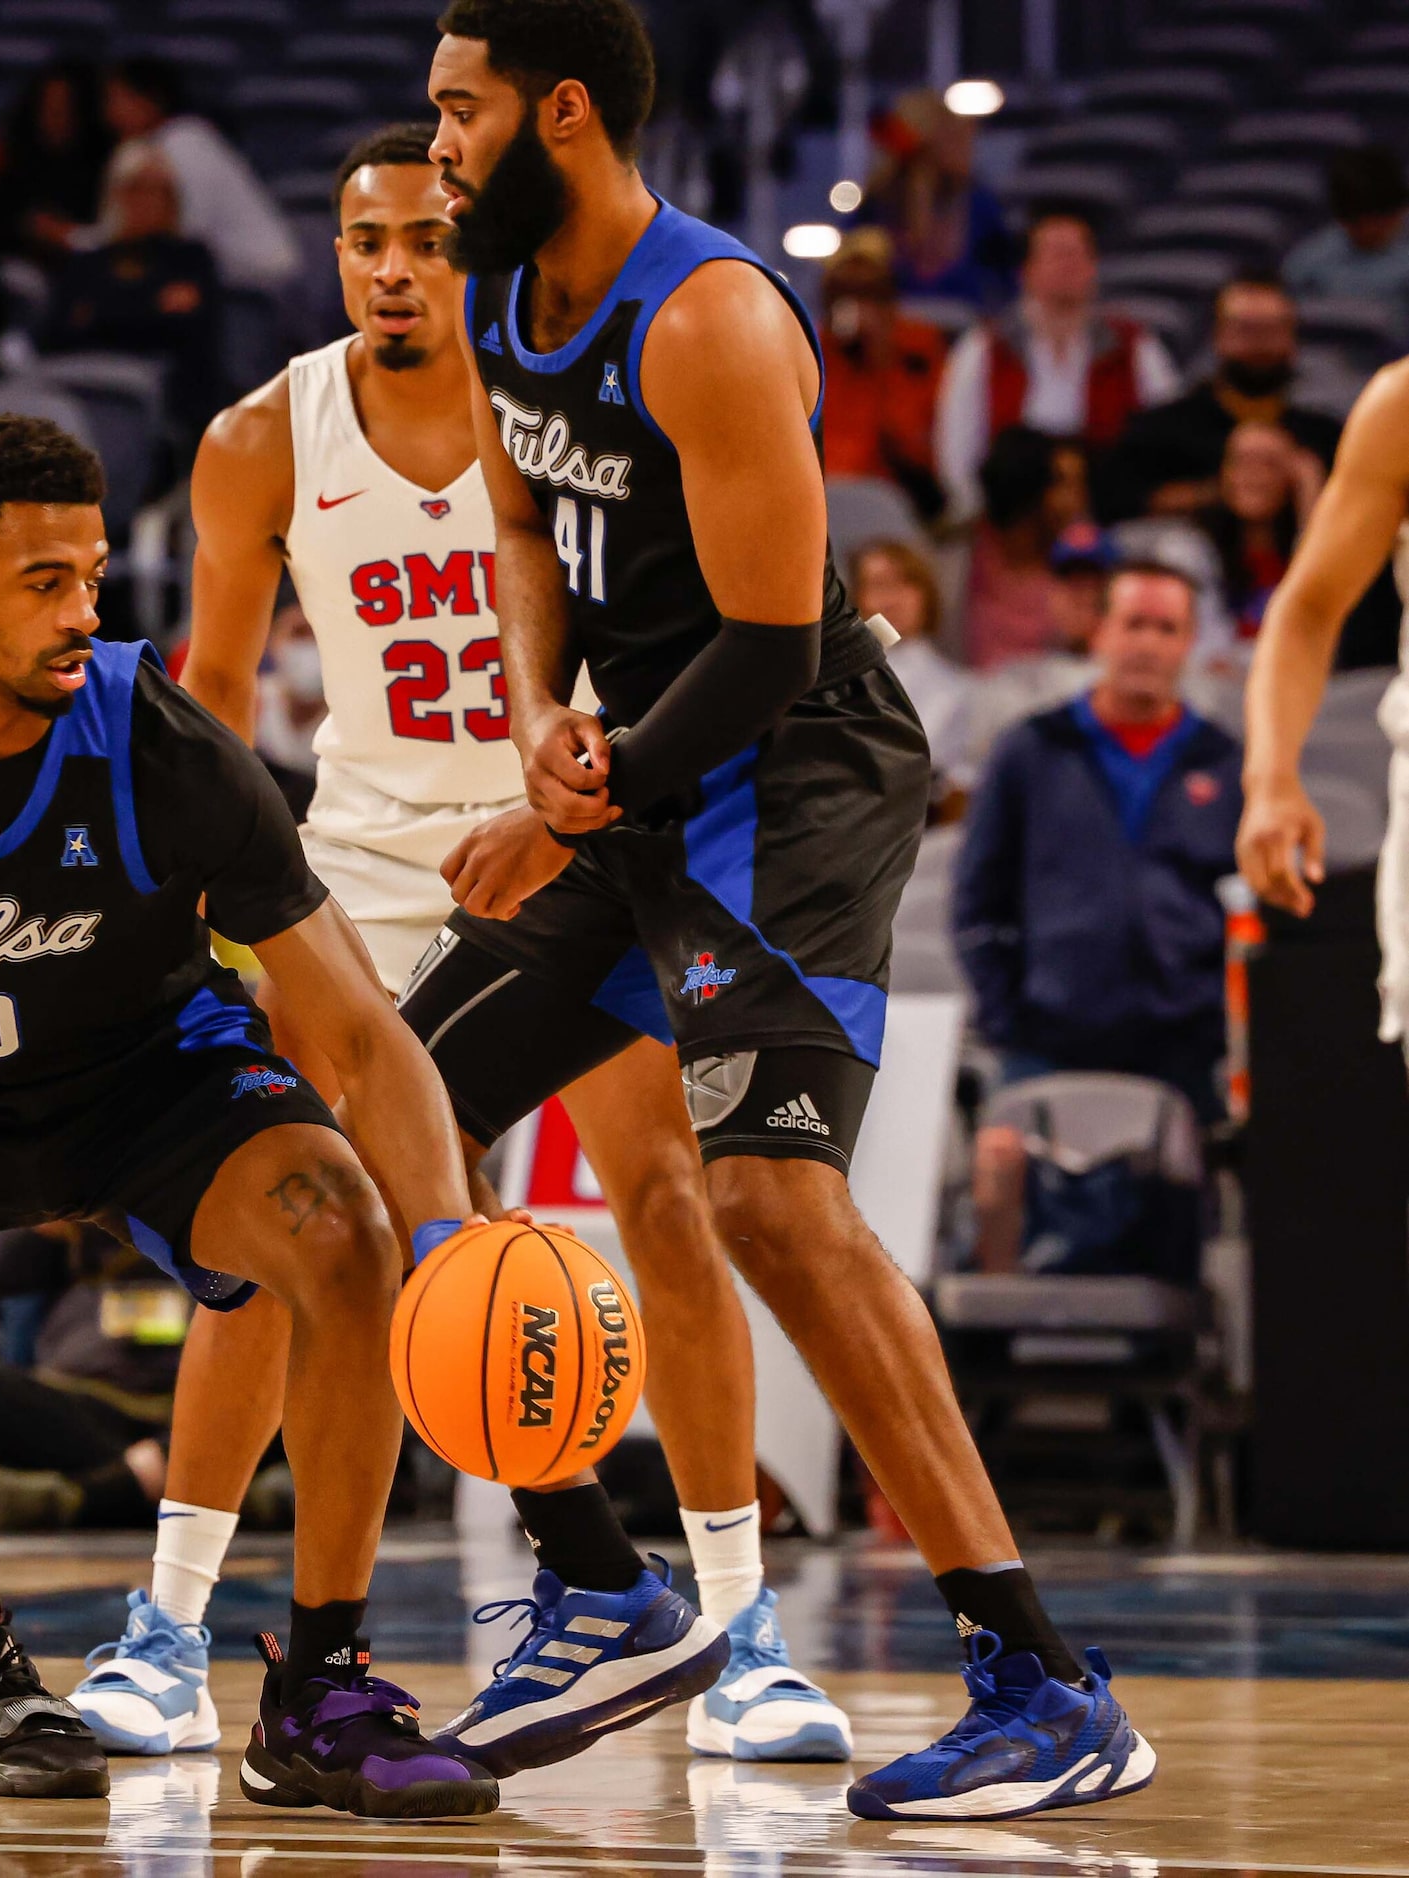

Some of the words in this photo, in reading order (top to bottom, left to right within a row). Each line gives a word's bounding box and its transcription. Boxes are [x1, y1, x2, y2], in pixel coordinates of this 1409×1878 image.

[490, 389, 632, 500] Tulsa
[350, 550, 496, 627] SM
[553, 496, 607, 605] 41
[382, 636, 511, 742] 23
[680, 961, 737, 996] Tulsa
[231, 1069, 298, 1099] Tulsa
[766, 1113, 830, 1137] adidas
[518, 1302, 559, 1427] NCAA
[579, 1278, 631, 1449] Wilson
